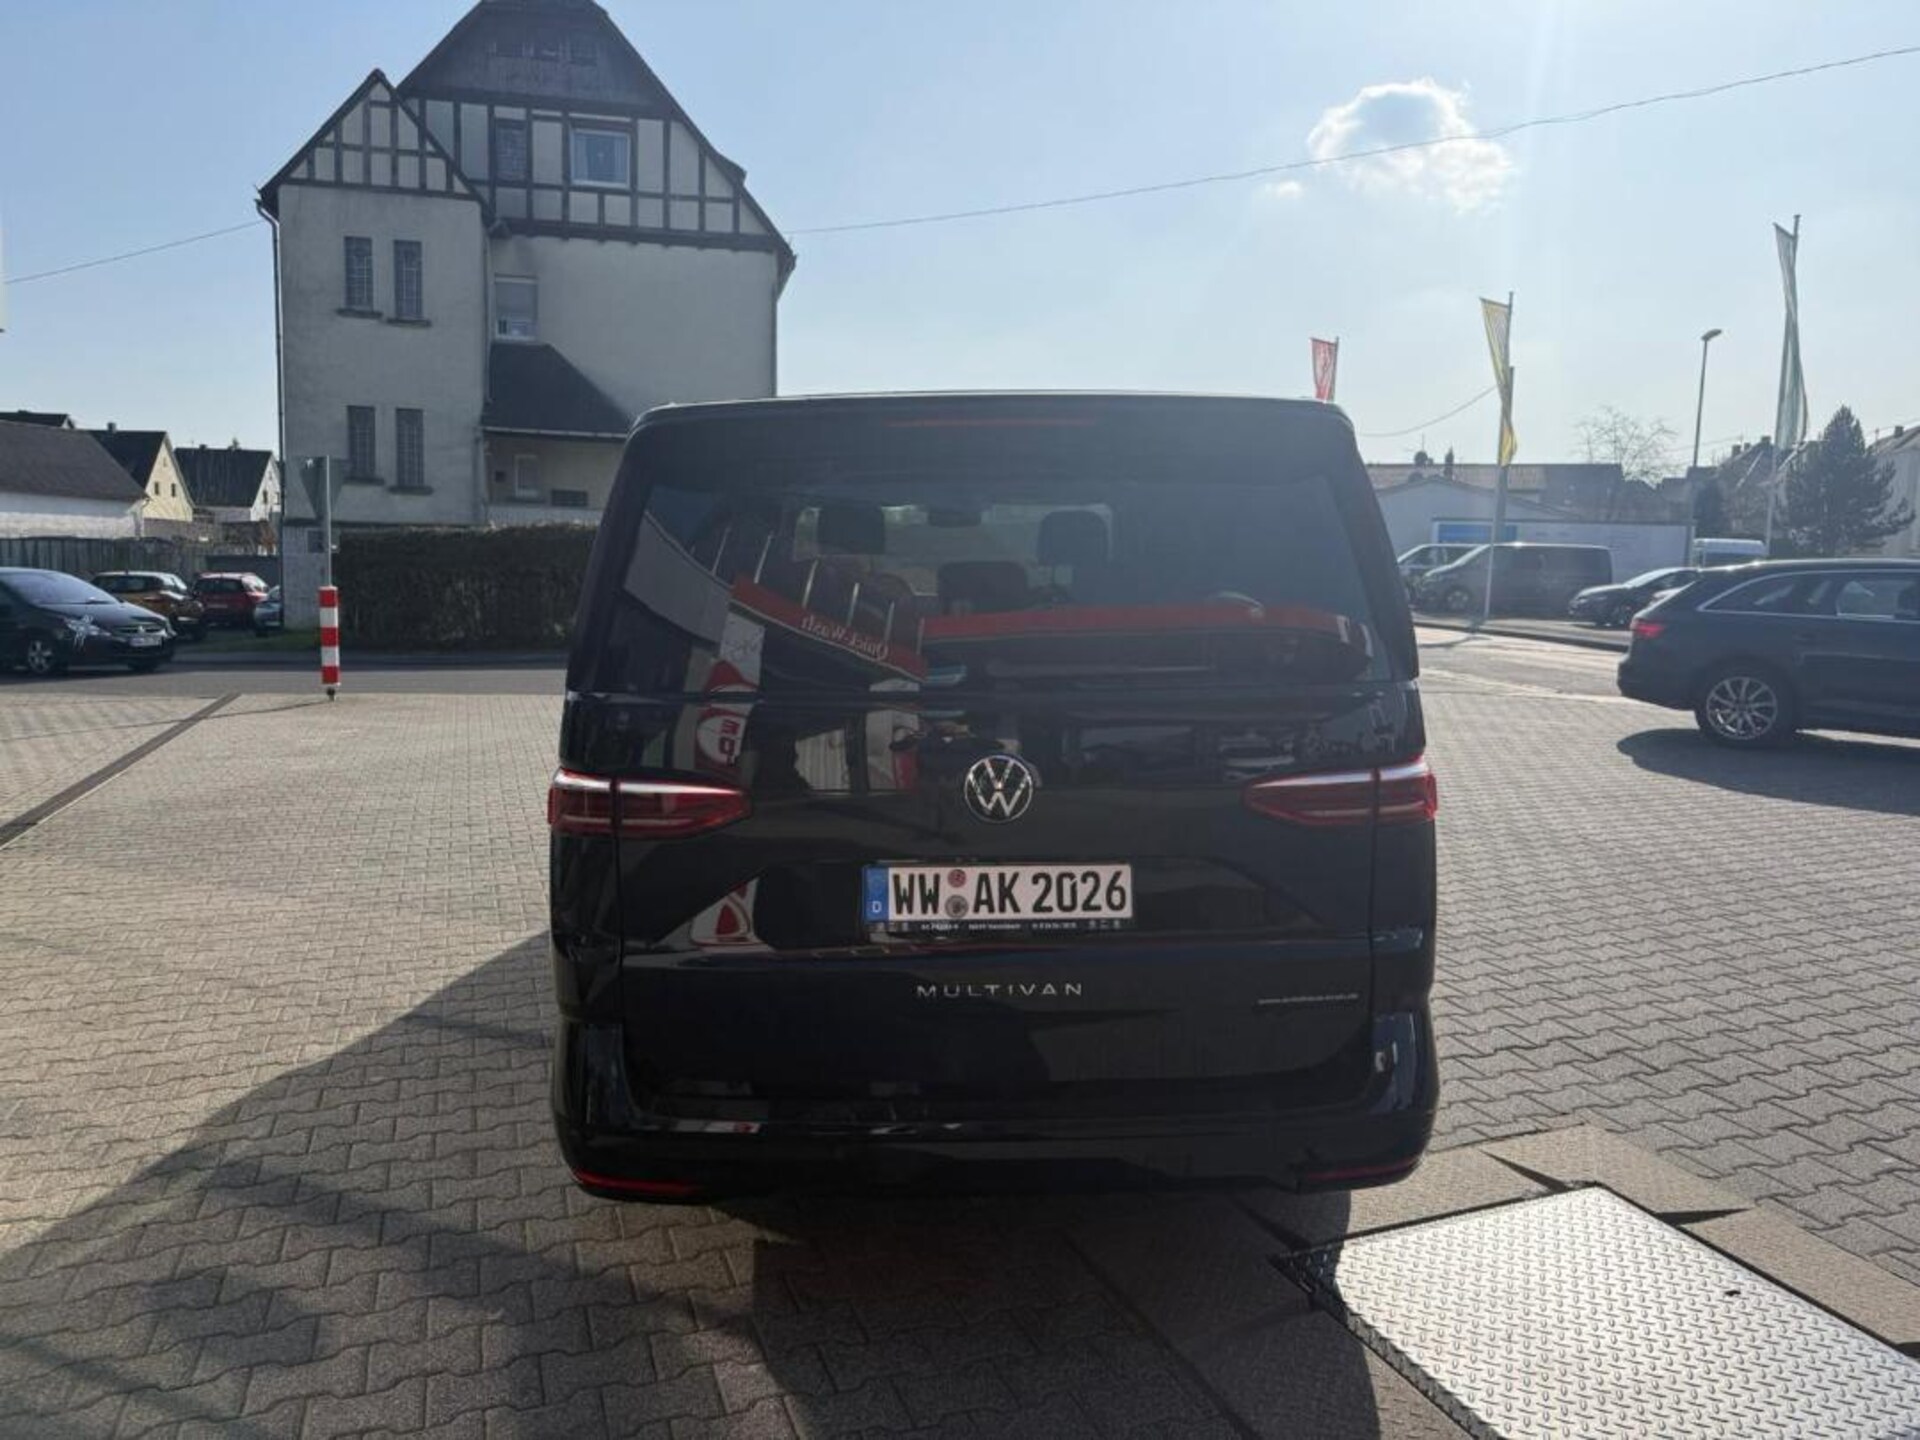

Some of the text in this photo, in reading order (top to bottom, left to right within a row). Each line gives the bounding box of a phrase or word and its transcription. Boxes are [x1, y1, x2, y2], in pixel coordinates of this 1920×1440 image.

[893, 870, 1126, 915] WW AK 2026
[872, 900, 881, 913] D
[916, 983, 1082, 998] MULTIVAN
